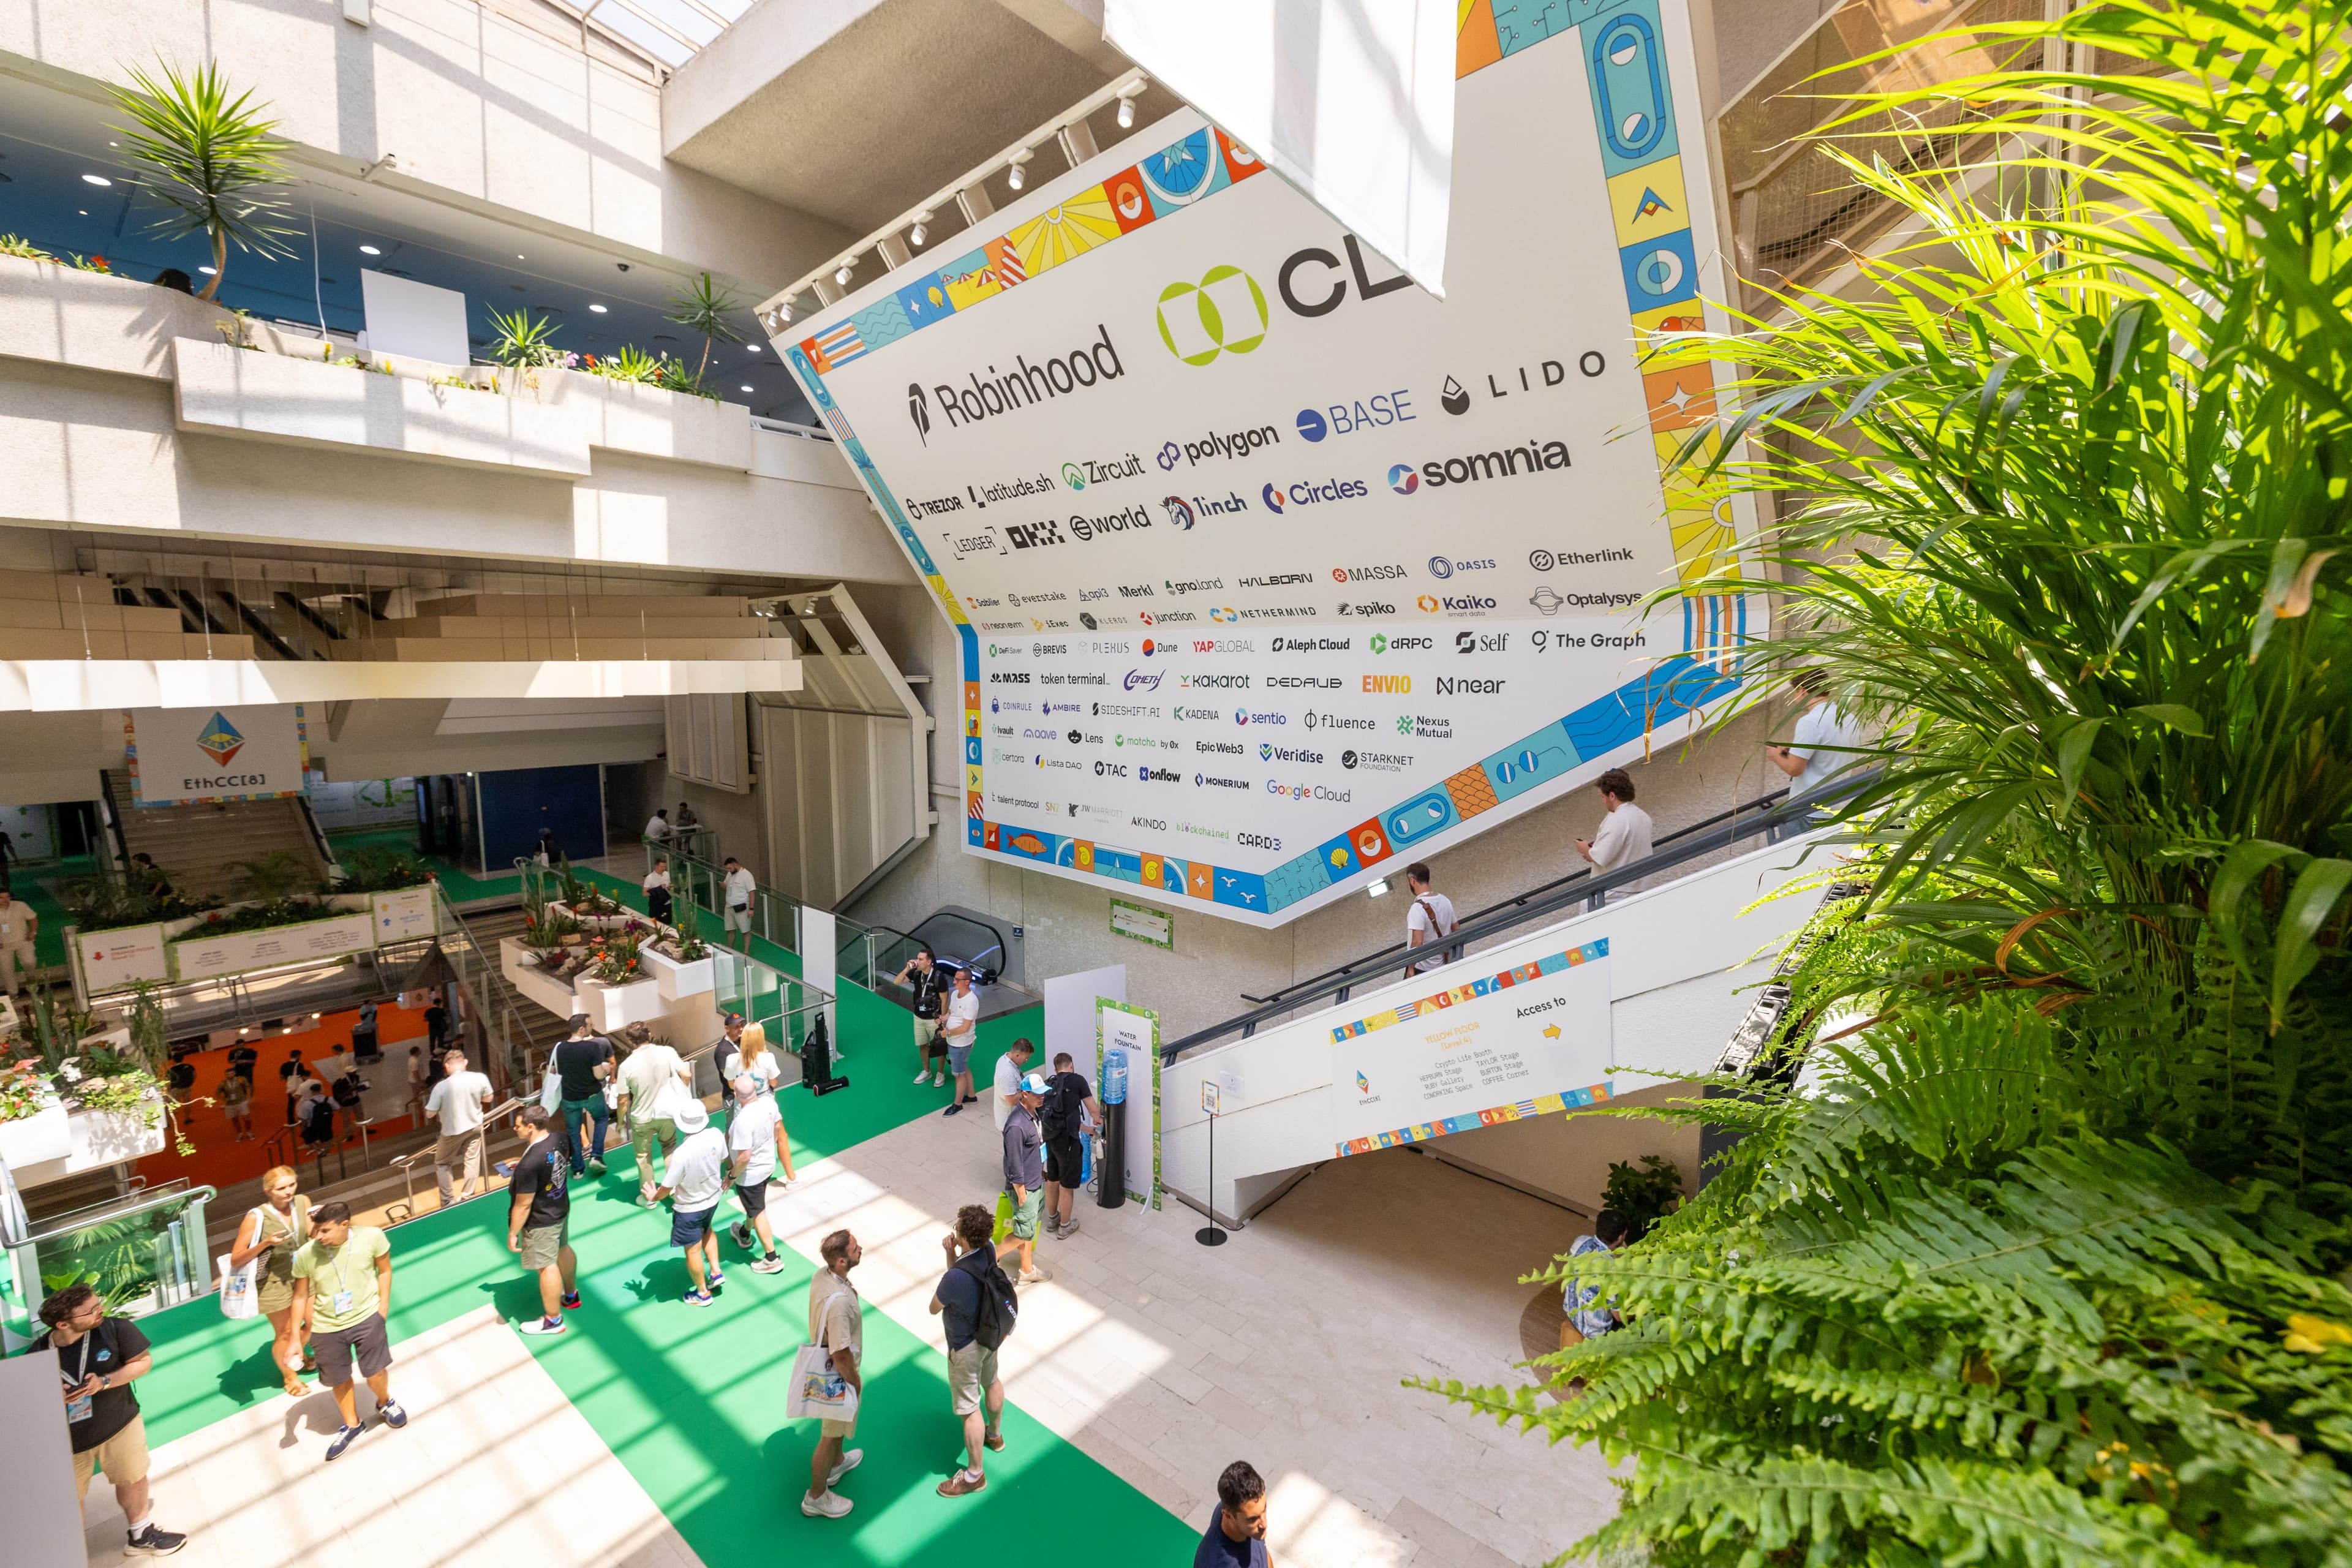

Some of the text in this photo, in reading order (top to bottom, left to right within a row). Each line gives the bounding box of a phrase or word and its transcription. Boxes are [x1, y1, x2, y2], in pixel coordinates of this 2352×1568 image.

[934, 324, 1125, 427] Robinhood
[1488, 351, 1605, 398] LIDO
[1329, 389, 1416, 435] BASE
[1184, 424, 1280, 466] polygon
[1082, 453, 1145, 484] Zircuit
[1422, 439, 1571, 486] somnia
[981, 473, 1055, 502] latitude.sh
[1289, 478, 1368, 505] Circles
[919, 496, 965, 516] TREZOR
[1193, 492, 1248, 517] 1inch
[1090, 505, 1152, 534] world
[953, 535, 996, 553] LEDGER
[1558, 548, 1634, 565] Etherlink
[1457, 559, 1496, 570] OASIS
[1238, 573, 1313, 587] HALBORN
[1348, 565, 1408, 582] MASSA
[1118, 585, 1154, 598] Merkl
[1175, 578, 1224, 595] gno.land
[1022, 592, 1066, 603] everstake
[1088, 589, 1109, 601] api3
[1567, 592, 1642, 608] Optalysys
[976, 597, 1000, 608] Sablier
[1355, 601, 1395, 616] spiko
[1443, 595, 1496, 611] Kaiko
[1154, 611, 1196, 624] junction
[1240, 606, 1316, 619] NETHERMIND
[1046, 620, 1069, 628] iExec
[1093, 642, 1129, 654] PLEXUS
[1158, 643, 1177, 652] Dune
[1286, 639, 1350, 652] Aleph Cloud
[1391, 637, 1433, 650] dRPC
[1480, 633, 1509, 652] Self
[1556, 633, 1645, 650] The Graph
[1043, 645, 1066, 654] BREVIS
[1041, 674, 1065, 684] token
[1193, 674, 1250, 689] kakarot
[1267, 677, 1342, 688] DEDAUB
[1362, 675, 1411, 694] ENVIO
[1458, 677, 1506, 694] near
[1003, 702, 1032, 711] COINRULE
[1053, 704, 1080, 712] AMBIRE
[1101, 705, 1160, 718] SIDESHIFT.AI
[1186, 709, 1219, 720] KADENA
[1252, 712, 1286, 725] sentio
[1417, 716, 1449, 726] Nexus
[1321, 715, 1375, 729] fluence
[1085, 733, 1103, 744] Lens
[1417, 728, 1452, 739] Mutual
[1127, 737, 1156, 747] matcha
[1161, 741, 1168, 750] by
[1196, 741, 1243, 754] Epic Web3
[1002, 754, 1024, 763] certora
[1275, 748, 1323, 763] Veridise
[1361, 753, 1414, 766] STARKNET
[1106, 764, 1127, 777] TAC
[1360, 763, 1401, 772] FOUNDATION
[184, 774, 266, 790] EthCC[8]
[1150, 769, 1180, 782] onflow
[1206, 777, 1249, 790] MONERIUM
[1267, 780, 1350, 802] Google Cloud
[998, 796, 1039, 809] talent protocol
[1091, 806, 1123, 818] MARRIOTT
[1131, 816, 1166, 831] AKINDO
[1238, 832, 1281, 851] CARD3
[1517, 997, 1566, 1019] Access to
[1119, 1030, 1137, 1040] WATER
[1425, 1022, 1480, 1043] YELLOW FLOOR
[1115, 1039, 1141, 1051] FOUNTAIN
[1435, 1049, 1492, 1069] Crypto Life Booth
[1476, 1052, 1519, 1067] TAYLOR Stage
[1420, 1067, 1462, 1082] HEPBURN Stage
[1480, 1061, 1523, 1076] BURTON Stage
[1441, 1076, 1464, 1086] Gallery
[1482, 1069, 1529, 1085] COFFEE Corner
[1457, 1084, 1472, 1093] Space
